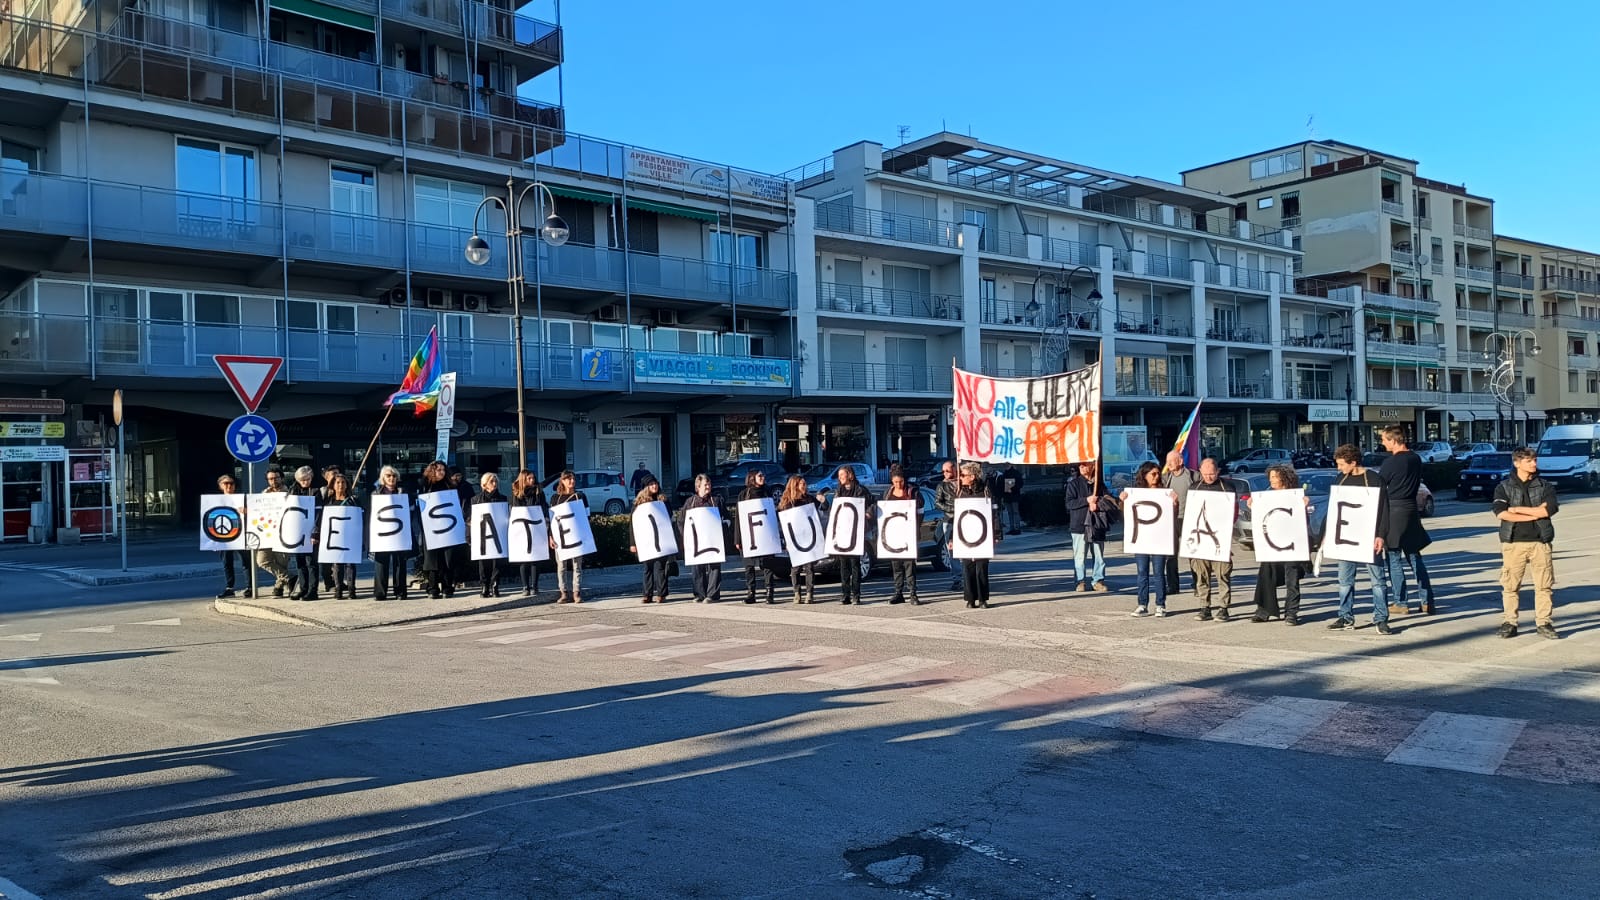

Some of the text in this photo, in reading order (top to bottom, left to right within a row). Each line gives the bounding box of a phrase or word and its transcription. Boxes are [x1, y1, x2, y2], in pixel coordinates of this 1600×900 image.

[630, 151, 690, 170] APPARTAMENTI
[638, 160, 683, 175] RESIDENCE
[649, 169, 673, 180] VILLE
[648, 359, 701, 374] VIAGGI
[731, 364, 782, 378] BOOKING
[955, 371, 996, 414] NO
[1027, 366, 1099, 420] GUERRE
[494, 425, 518, 434] Park
[957, 413, 994, 458] NO
[1023, 410, 1096, 464] ARMI
